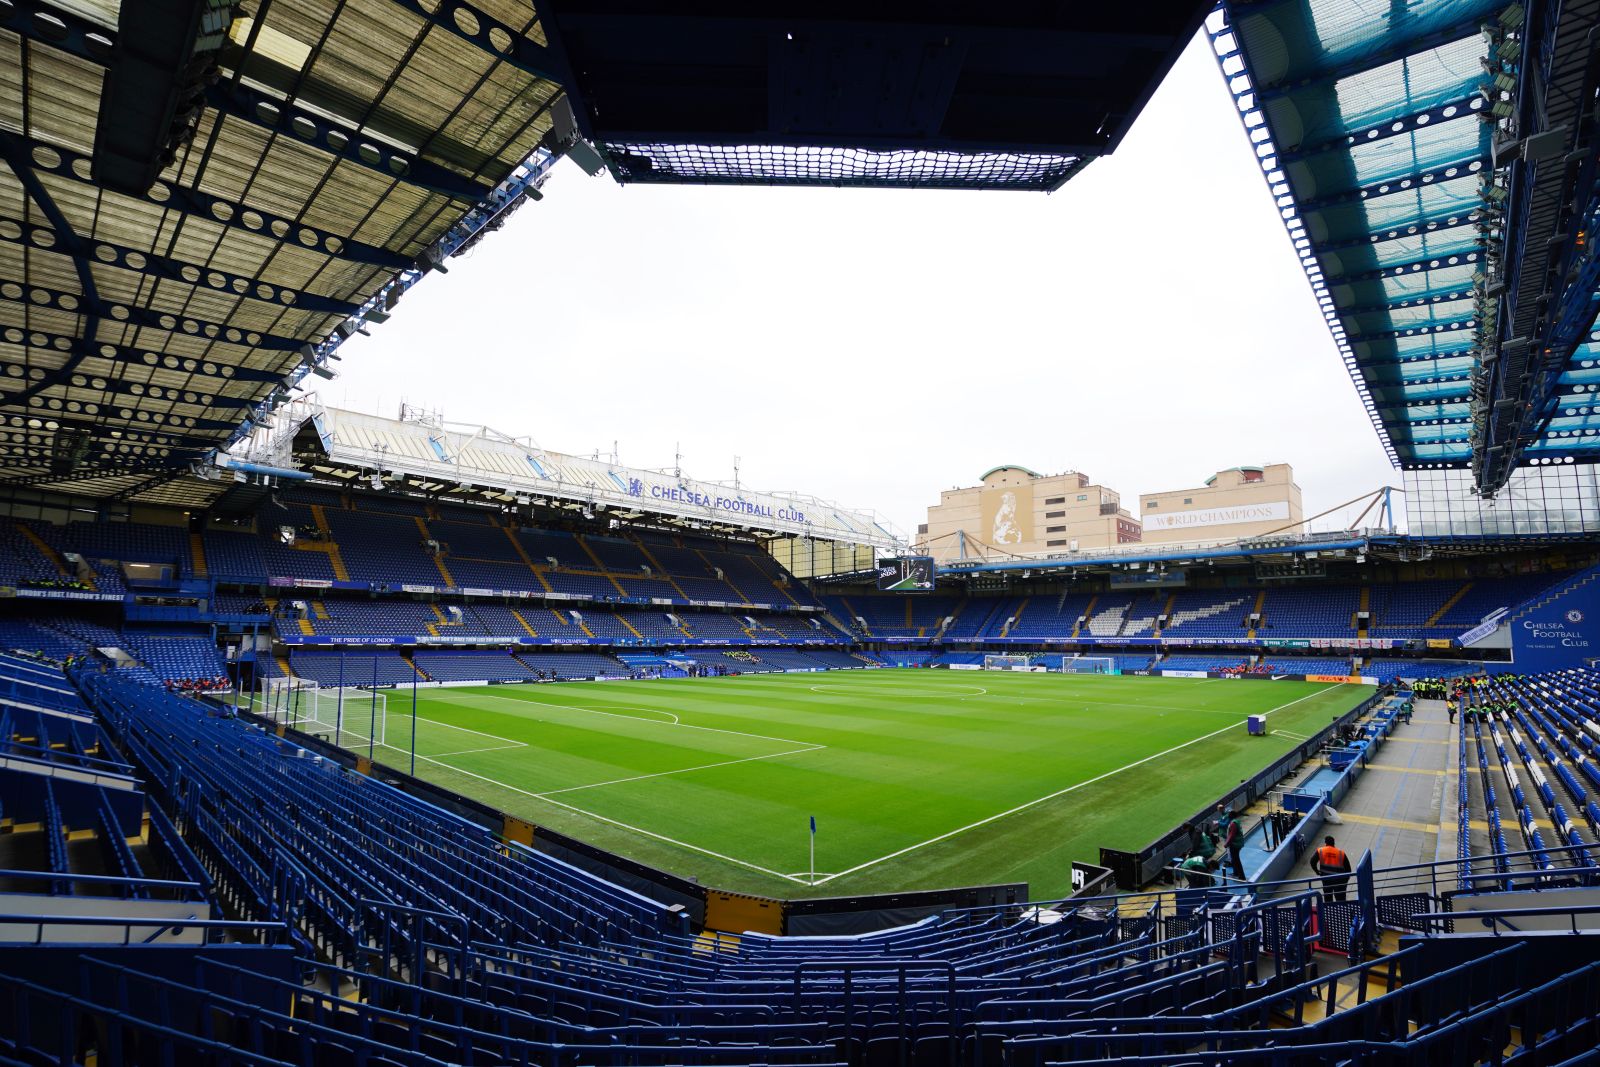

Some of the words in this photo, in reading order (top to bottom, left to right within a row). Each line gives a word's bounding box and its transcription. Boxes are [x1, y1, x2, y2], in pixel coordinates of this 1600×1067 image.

[652, 486, 710, 506] CHELSEA
[716, 497, 772, 517] FOOTBALL
[778, 509, 804, 522] CLUB
[1200, 506, 1272, 522] CHAMPIONS
[1562, 638, 1589, 647] CLUB
